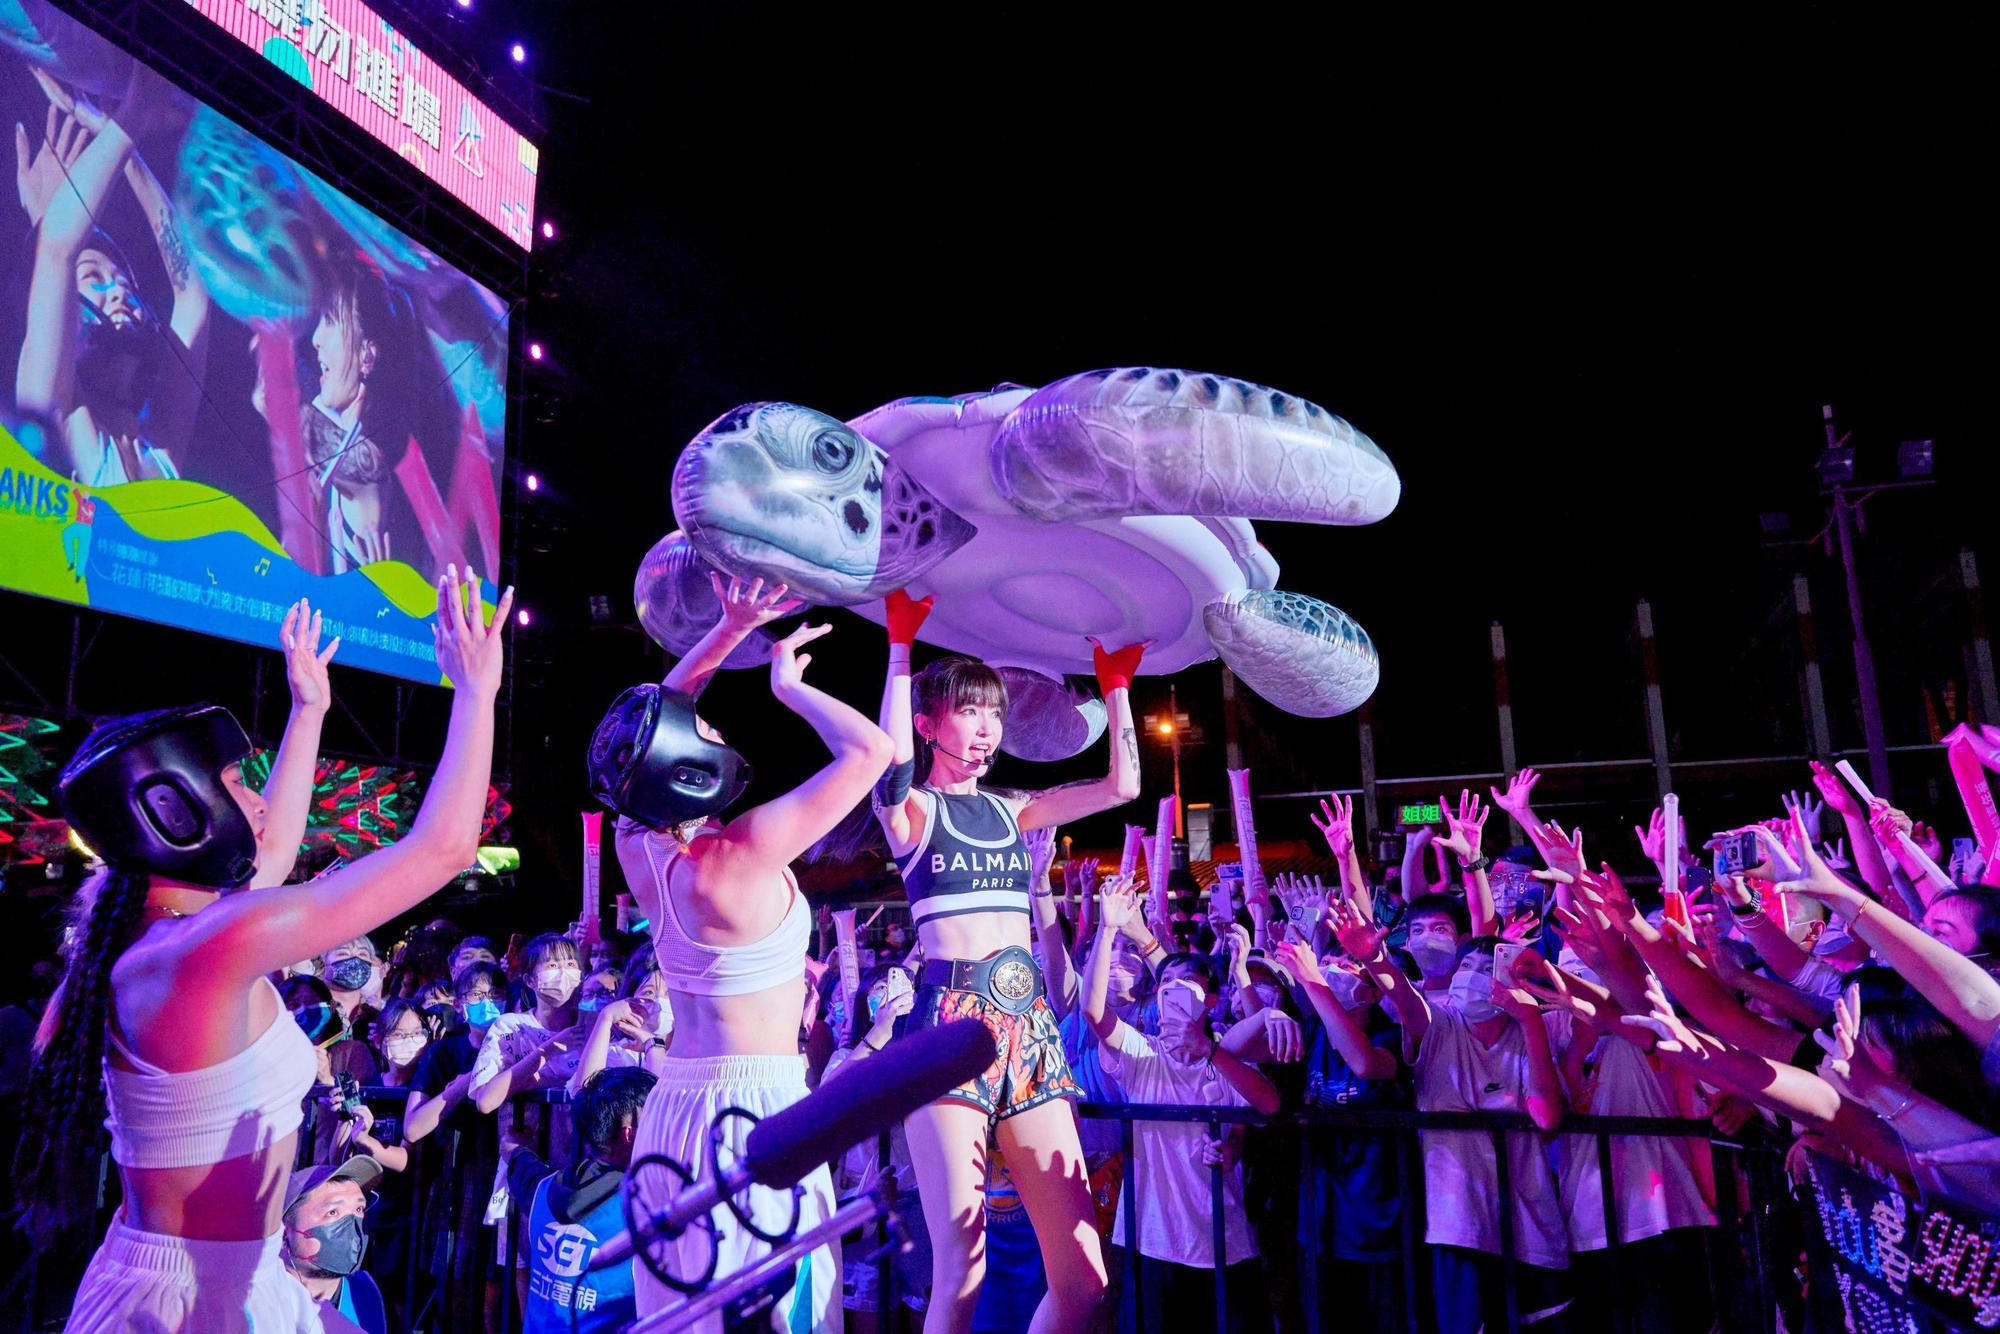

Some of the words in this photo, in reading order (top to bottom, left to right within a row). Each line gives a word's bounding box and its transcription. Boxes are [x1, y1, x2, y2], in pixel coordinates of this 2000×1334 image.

[1401, 805, 1440, 823] 姐姐
[931, 851, 1033, 873] BALMAI
[972, 877, 1014, 889] PARIS
[536, 1228, 599, 1272] SET
[530, 1268, 598, 1312] 三立電視
